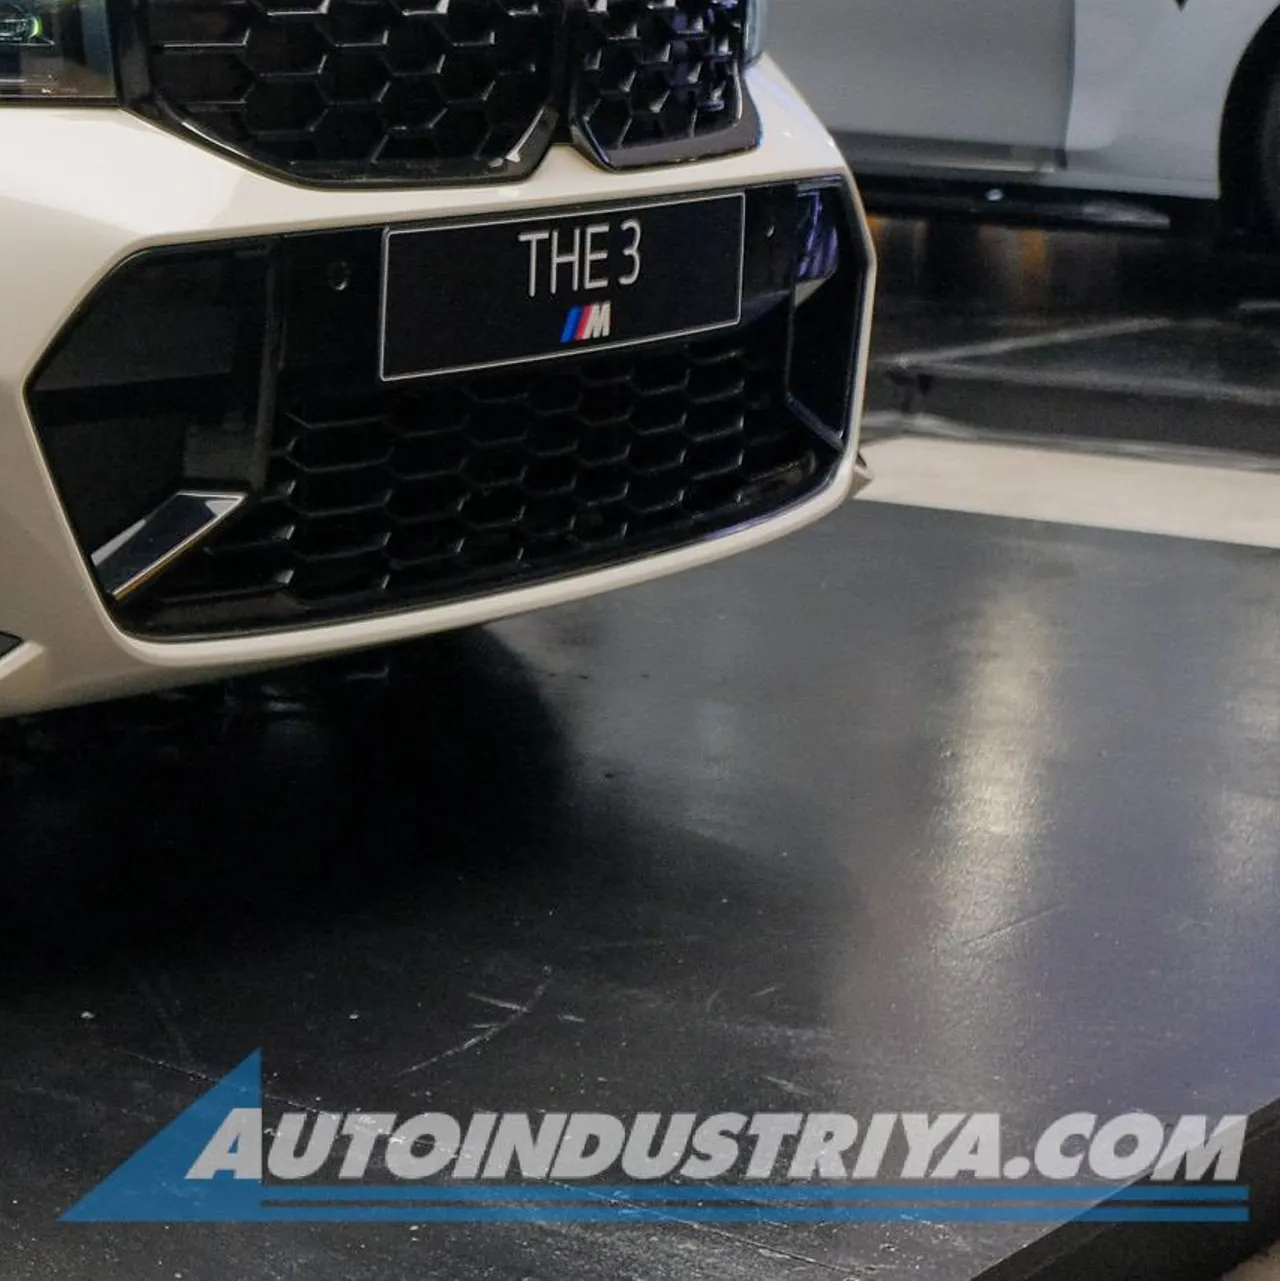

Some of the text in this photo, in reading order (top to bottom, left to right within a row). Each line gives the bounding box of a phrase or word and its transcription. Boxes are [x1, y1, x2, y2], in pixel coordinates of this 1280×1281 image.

[518, 219, 641, 297] THE 3
[580, 300, 612, 341] M
